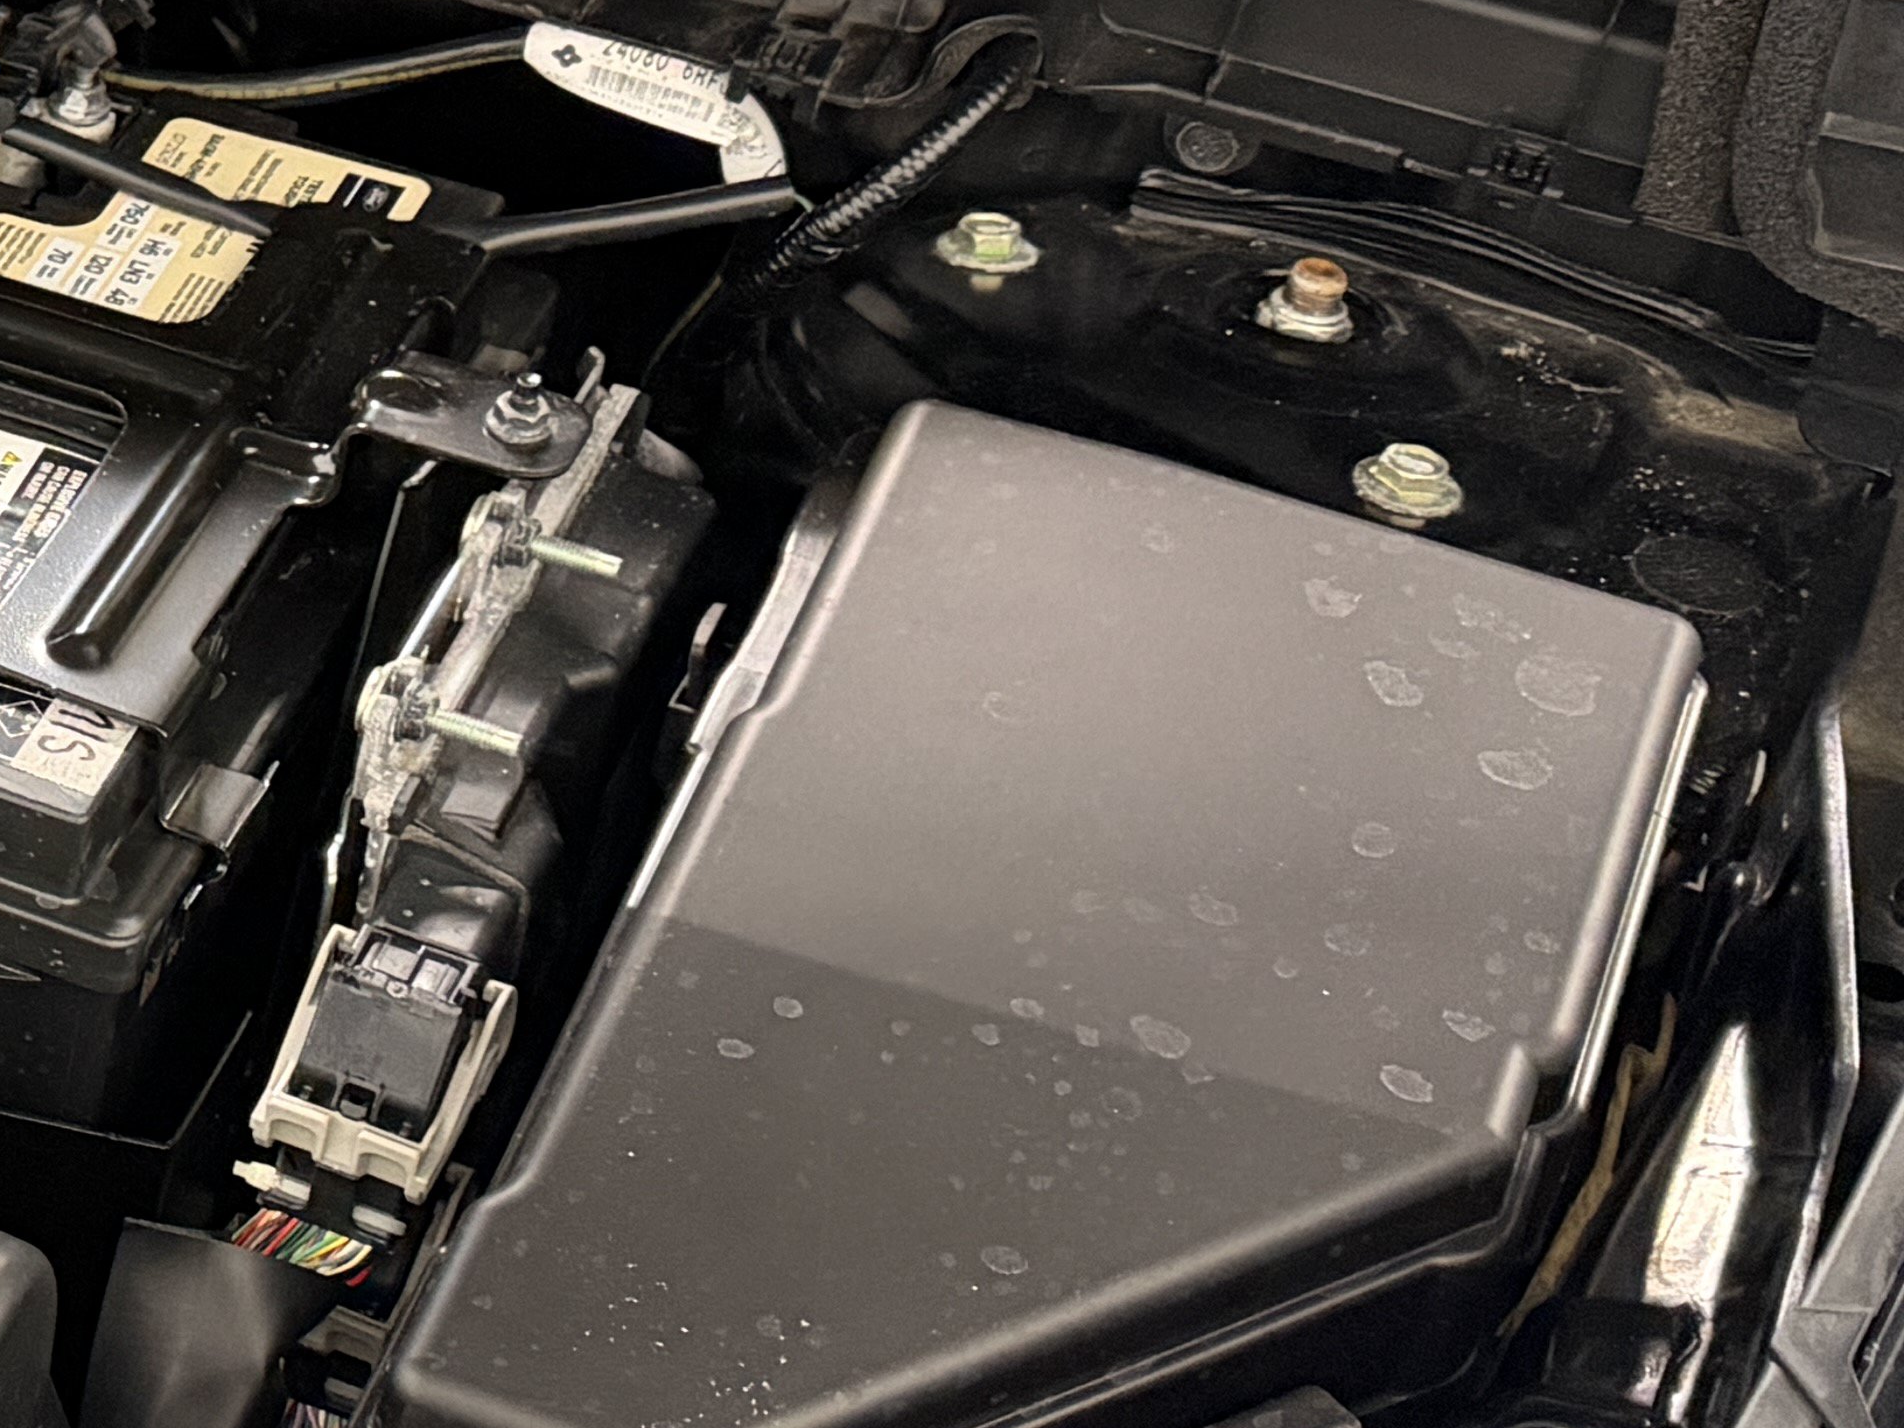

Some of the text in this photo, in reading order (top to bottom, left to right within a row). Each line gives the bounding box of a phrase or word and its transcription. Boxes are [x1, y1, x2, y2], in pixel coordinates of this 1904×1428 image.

[118, 200, 151, 226] 760
[45, 246, 73, 265] 70
[82, 252, 114, 276] 120
[102, 237, 167, 306] H6 LN3 48
